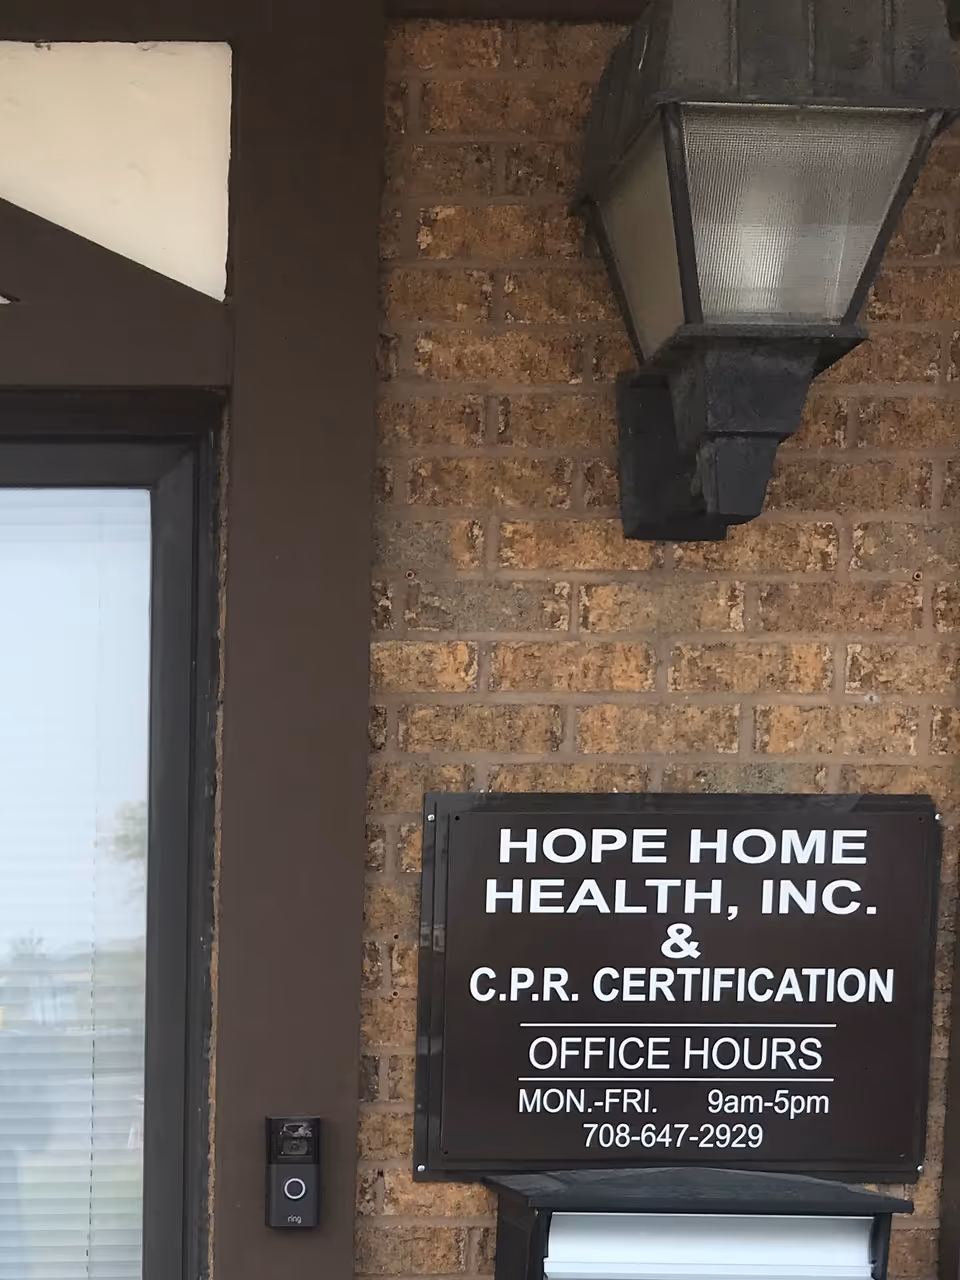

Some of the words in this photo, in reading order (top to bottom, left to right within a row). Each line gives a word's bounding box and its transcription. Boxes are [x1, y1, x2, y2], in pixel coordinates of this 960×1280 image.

[500, 828, 667, 863] HOPE
[690, 829, 867, 864] HOME
[486, 879, 738, 920] HEALTH,
[762, 880, 876, 914] INC.
[661, 923, 701, 958] &
[470, 967, 578, 1001] C.P.R.
[594, 967, 894, 1002] CERTIFICATION
[529, 1037, 670, 1069] OFFICE
[685, 1037, 822, 1070] HOURS
[519, 1089, 657, 1112] MON.-FRI.
[708, 1089, 829, 1119] 9am-5pm
[584, 1124, 762, 1148] 708-647-2929
[287, 1215, 302, 1224] ring
